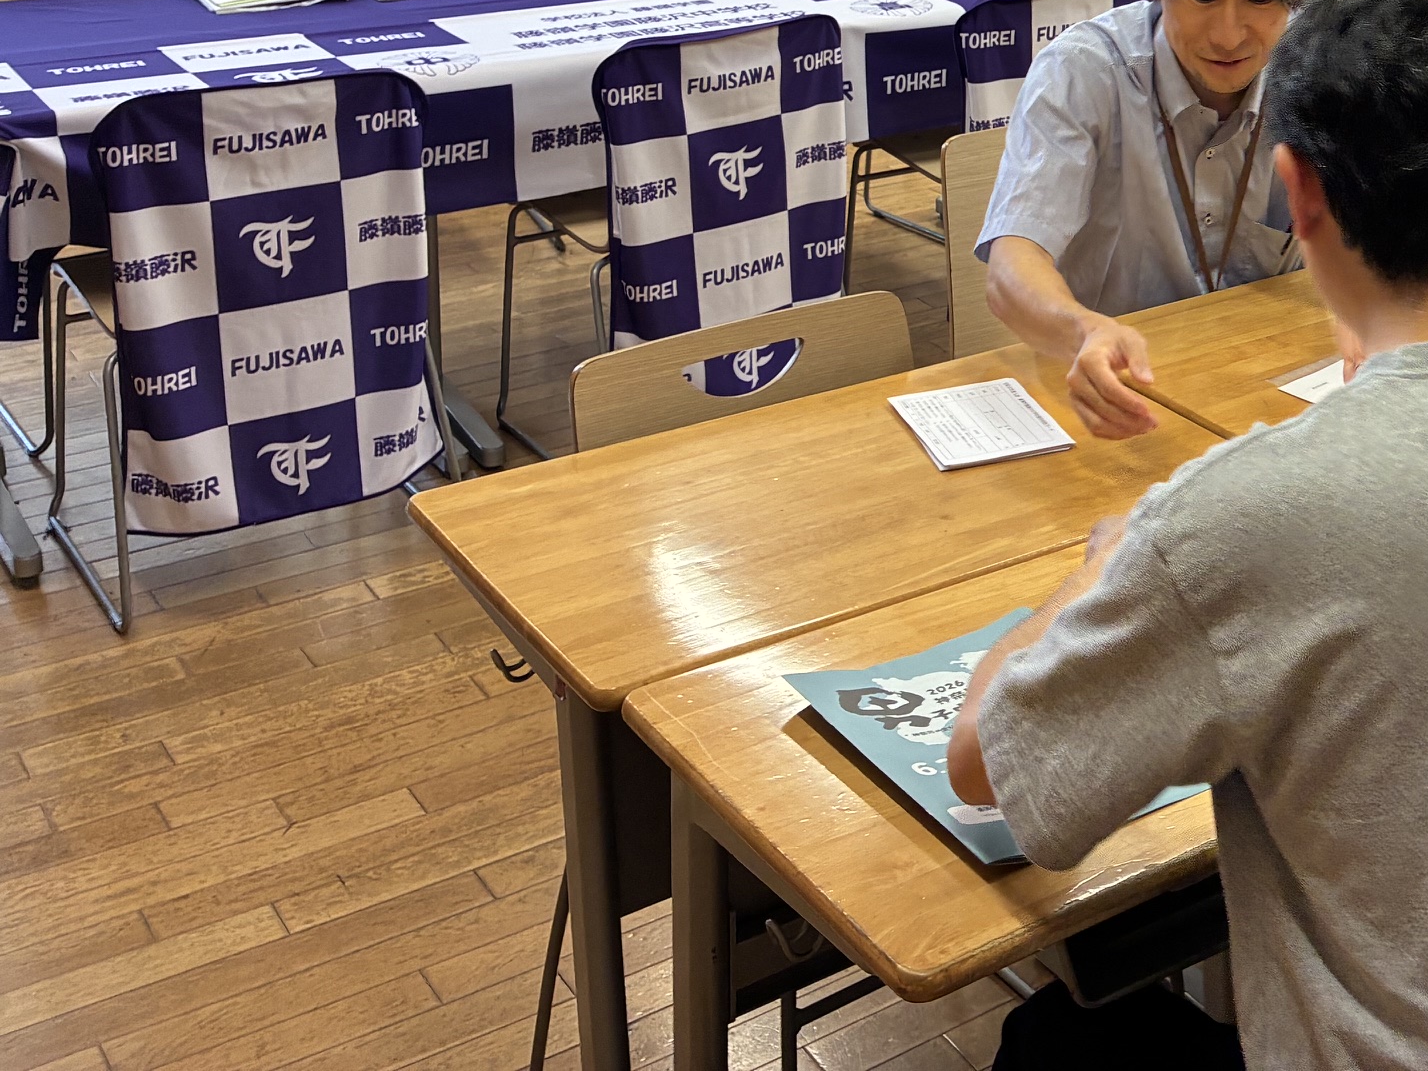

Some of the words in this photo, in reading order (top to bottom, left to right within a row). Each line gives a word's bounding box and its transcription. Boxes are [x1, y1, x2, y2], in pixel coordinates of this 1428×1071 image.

[182, 44, 310, 61] FUJISAWA
[337, 31, 426, 45] TOHREI
[959, 29, 1016, 49] TOHREI
[46, 60, 147, 75] TOHREI
[793, 46, 842, 75] TOHRE
[687, 65, 775, 95] FUJISAWA
[882, 68, 947, 95] TOHREI
[212, 123, 328, 156] FUJISAWA
[532, 121, 605, 152] 藤嶺藤
[421, 138, 489, 168] OHREI
[795, 142, 848, 168] 藤嶺藤
[358, 213, 426, 243] 藤嶺藤
[803, 235, 846, 260] TOHR
[702, 252, 785, 289] FUJISAWA
[370, 318, 428, 349] TOHR
[230, 338, 345, 378] FUJISAWA
[134, 366, 198, 396] OHREI
[926, 680, 964, 695] 2026
[933, 689, 968, 705] 神奈
